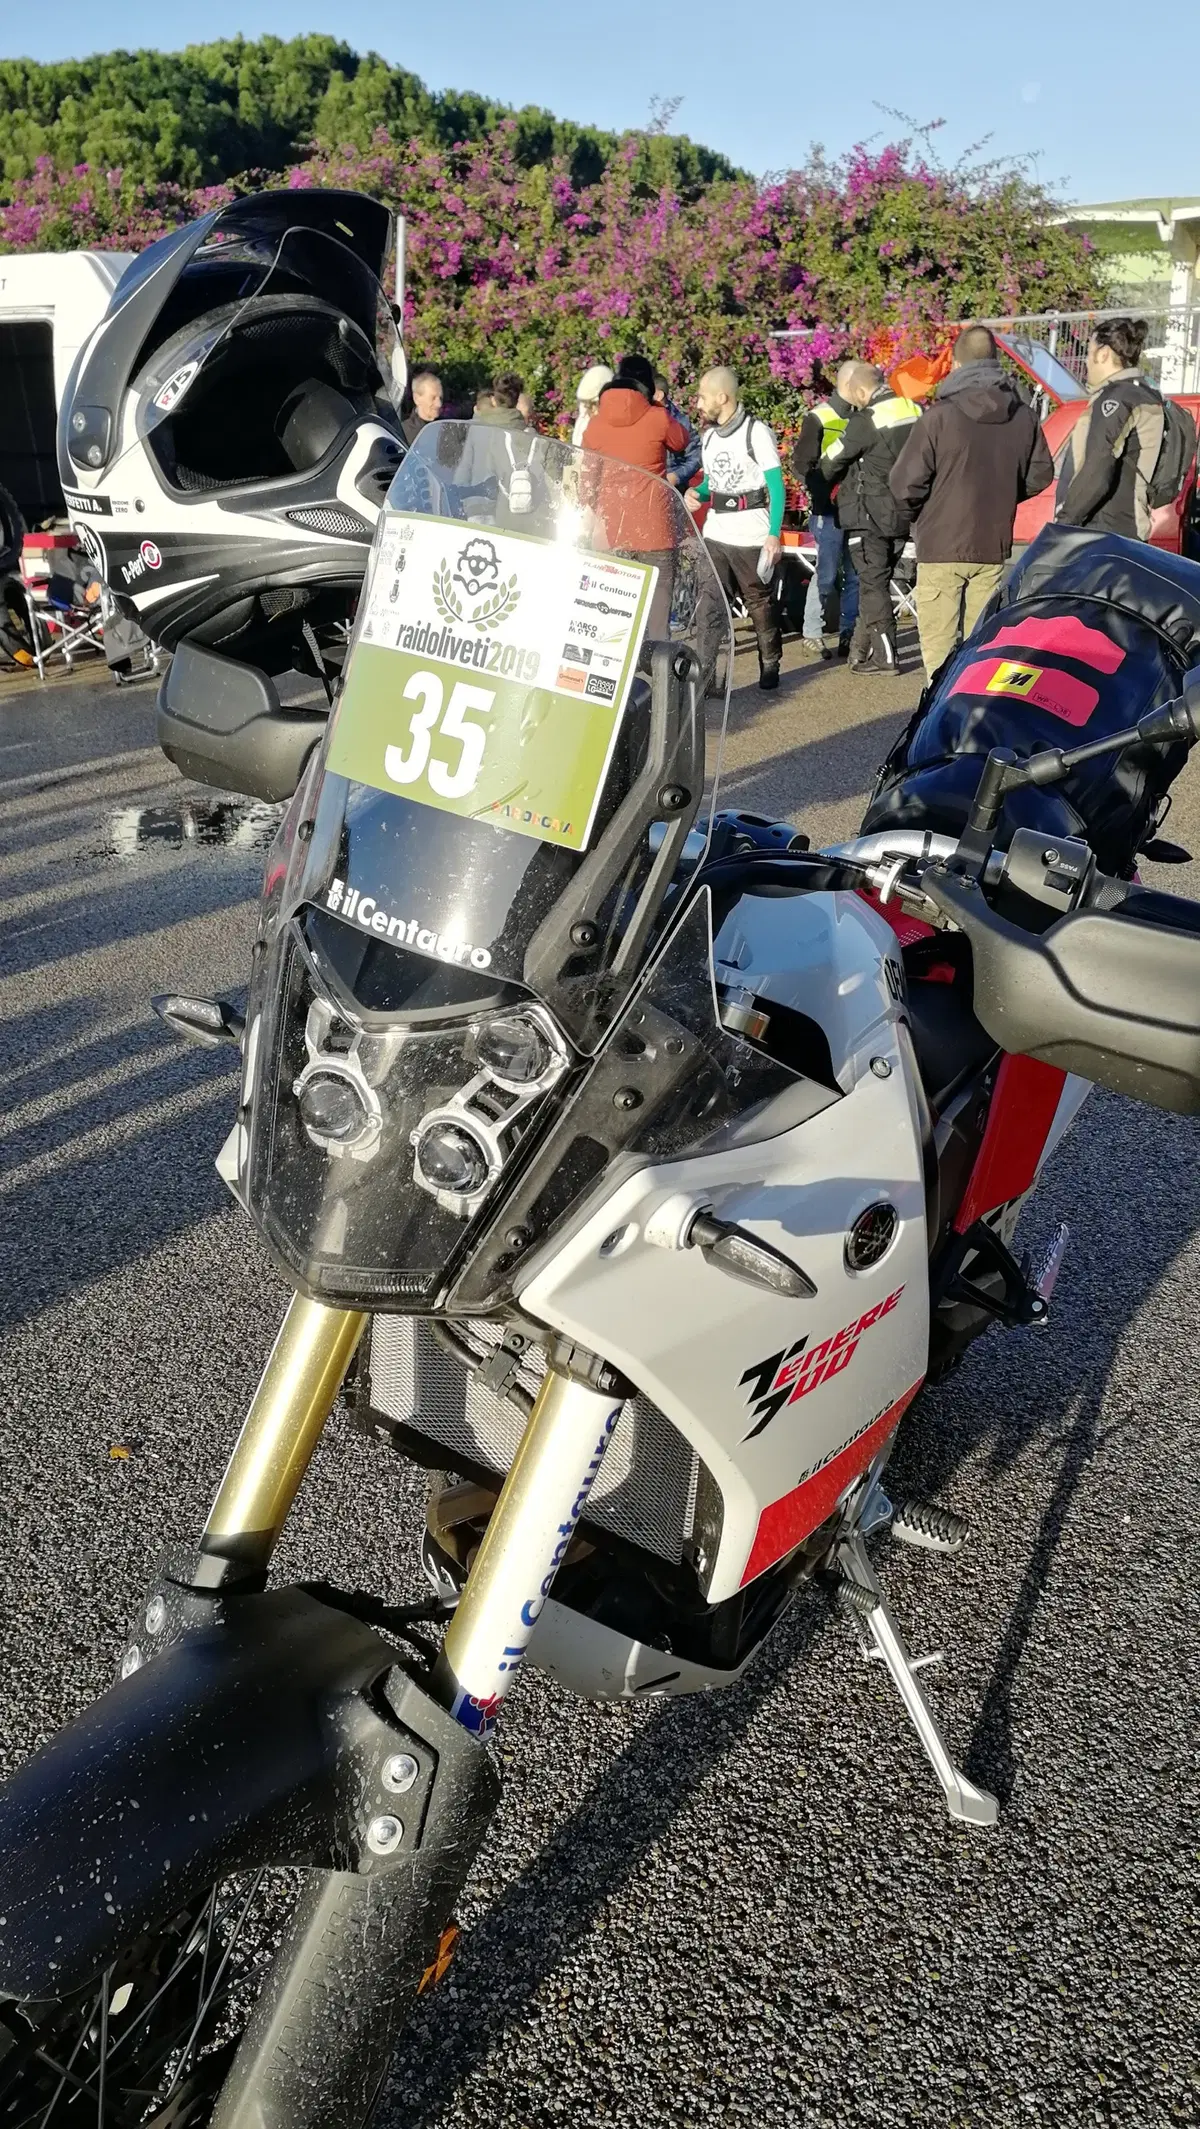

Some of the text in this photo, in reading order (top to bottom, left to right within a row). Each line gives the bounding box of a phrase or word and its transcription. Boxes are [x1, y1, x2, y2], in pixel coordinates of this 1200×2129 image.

[599, 583, 638, 599] Centauro
[384, 670, 497, 800] 35
[736, 1332, 862, 1446] 700
